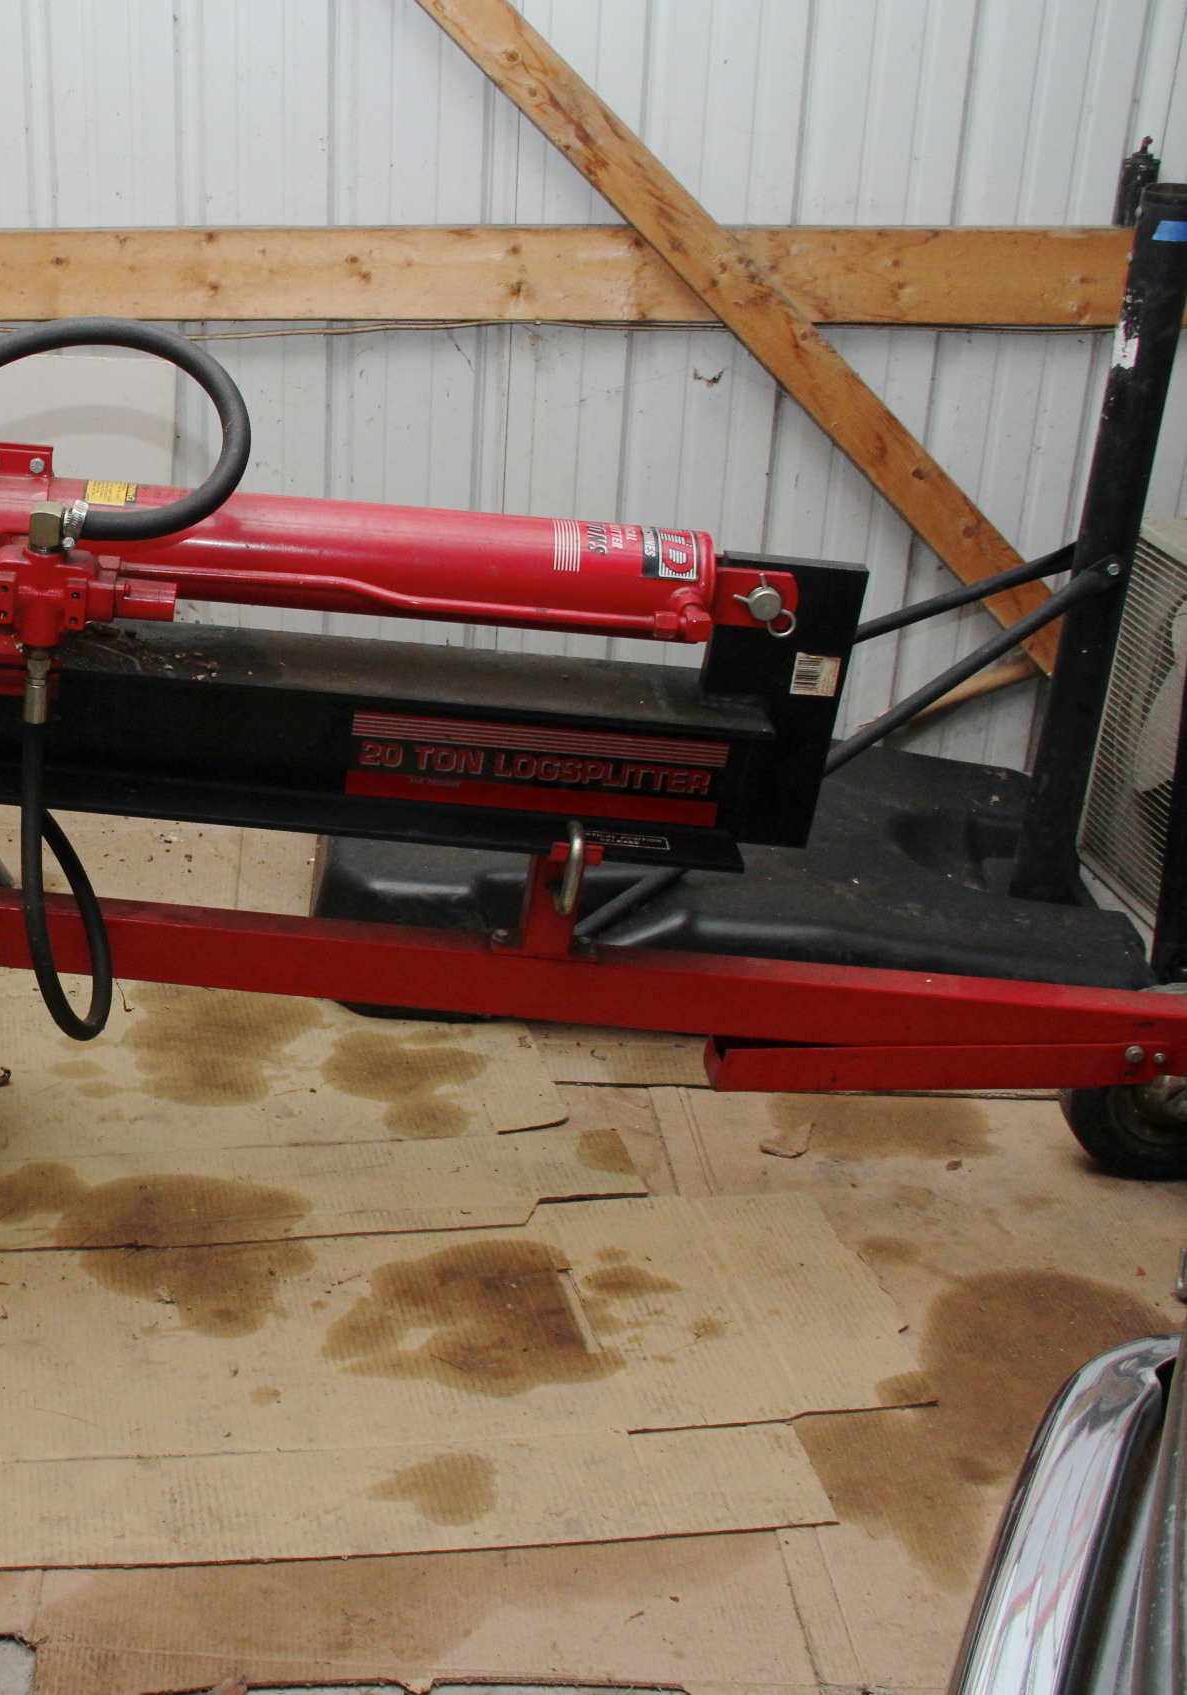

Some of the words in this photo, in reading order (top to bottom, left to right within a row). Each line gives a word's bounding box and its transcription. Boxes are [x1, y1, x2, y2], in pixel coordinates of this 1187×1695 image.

[359, 740, 404, 768] 20
[413, 744, 485, 775] TON
[494, 752, 711, 795] LOGSPLITTER
